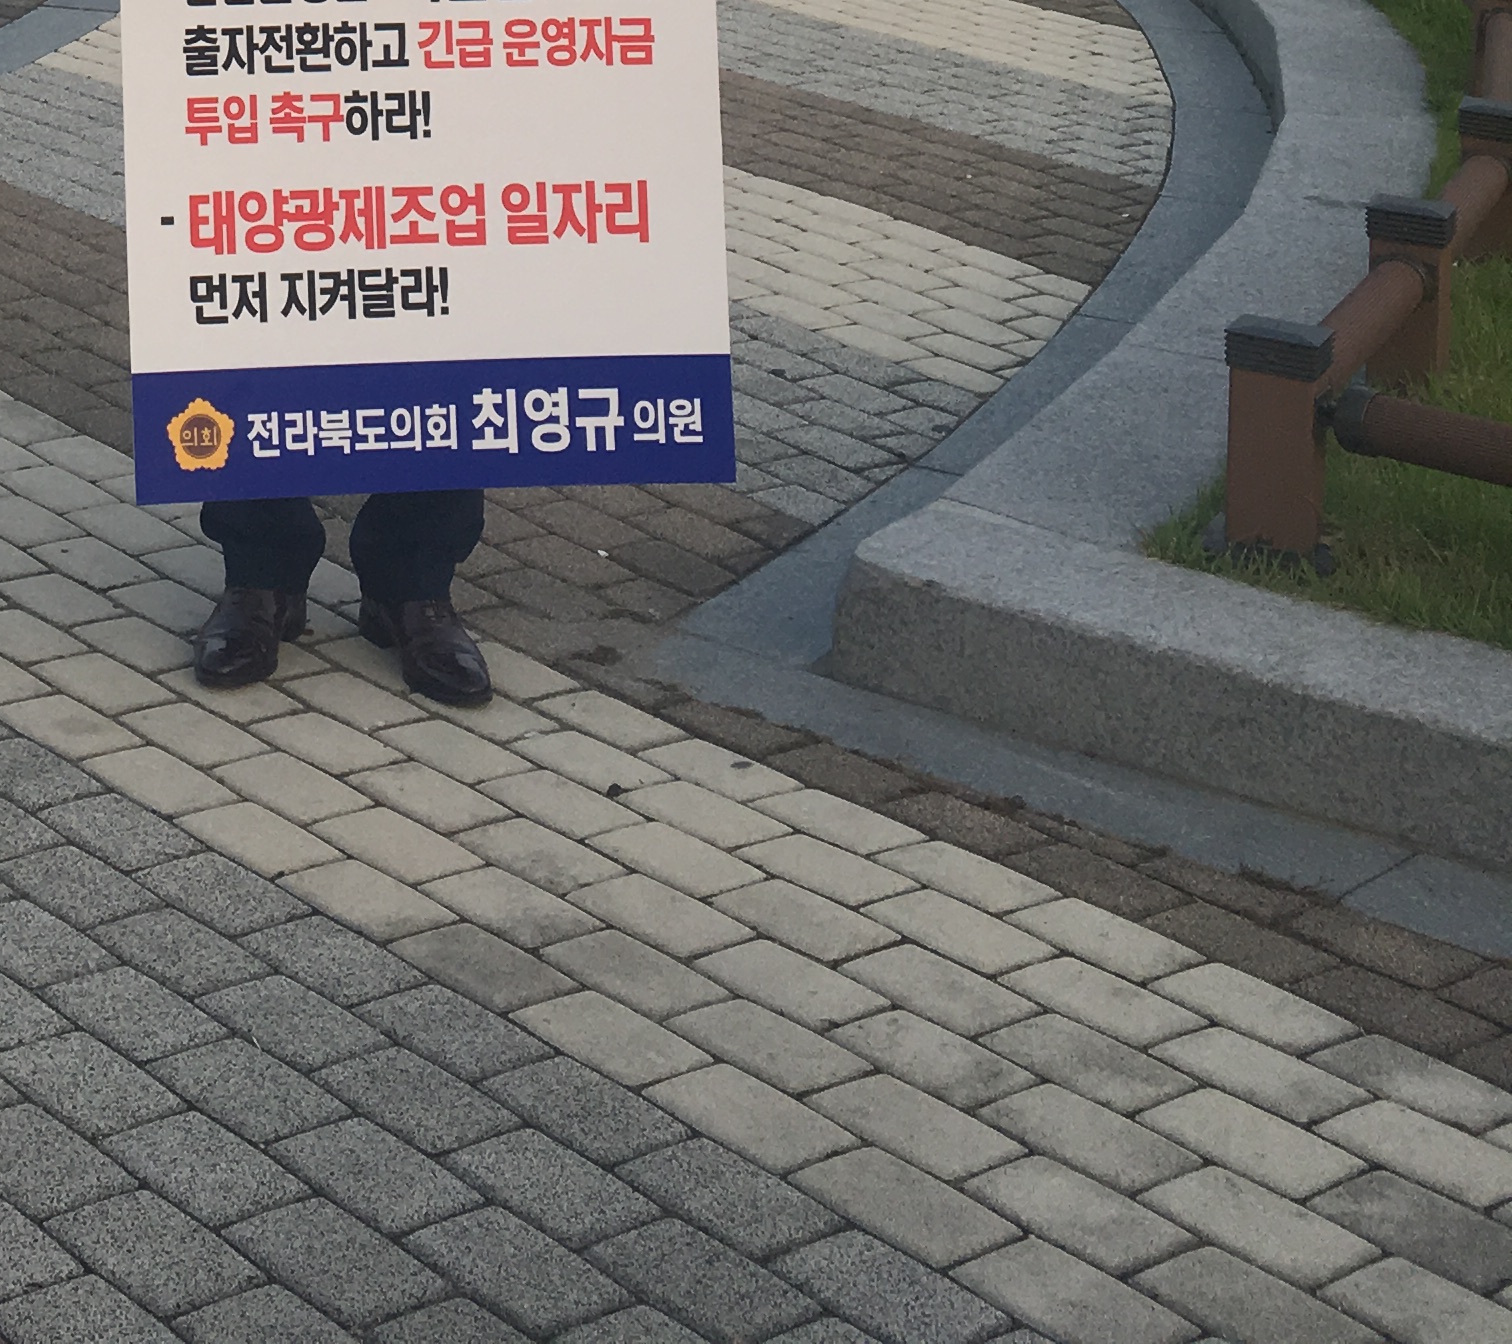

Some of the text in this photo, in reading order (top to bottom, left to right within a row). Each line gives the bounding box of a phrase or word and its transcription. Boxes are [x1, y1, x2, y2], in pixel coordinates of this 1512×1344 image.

[182, 16, 655, 77] 출자전환하고 긴급 운영자금
[184, 89, 432, 146] 투입 촉구하라!
[188, 179, 649, 255] 태양광제조업 일자리
[189, 266, 450, 325] 먼저 지켜달라!
[247, 387, 704, 458] 전라북도의회 최영규 의원
